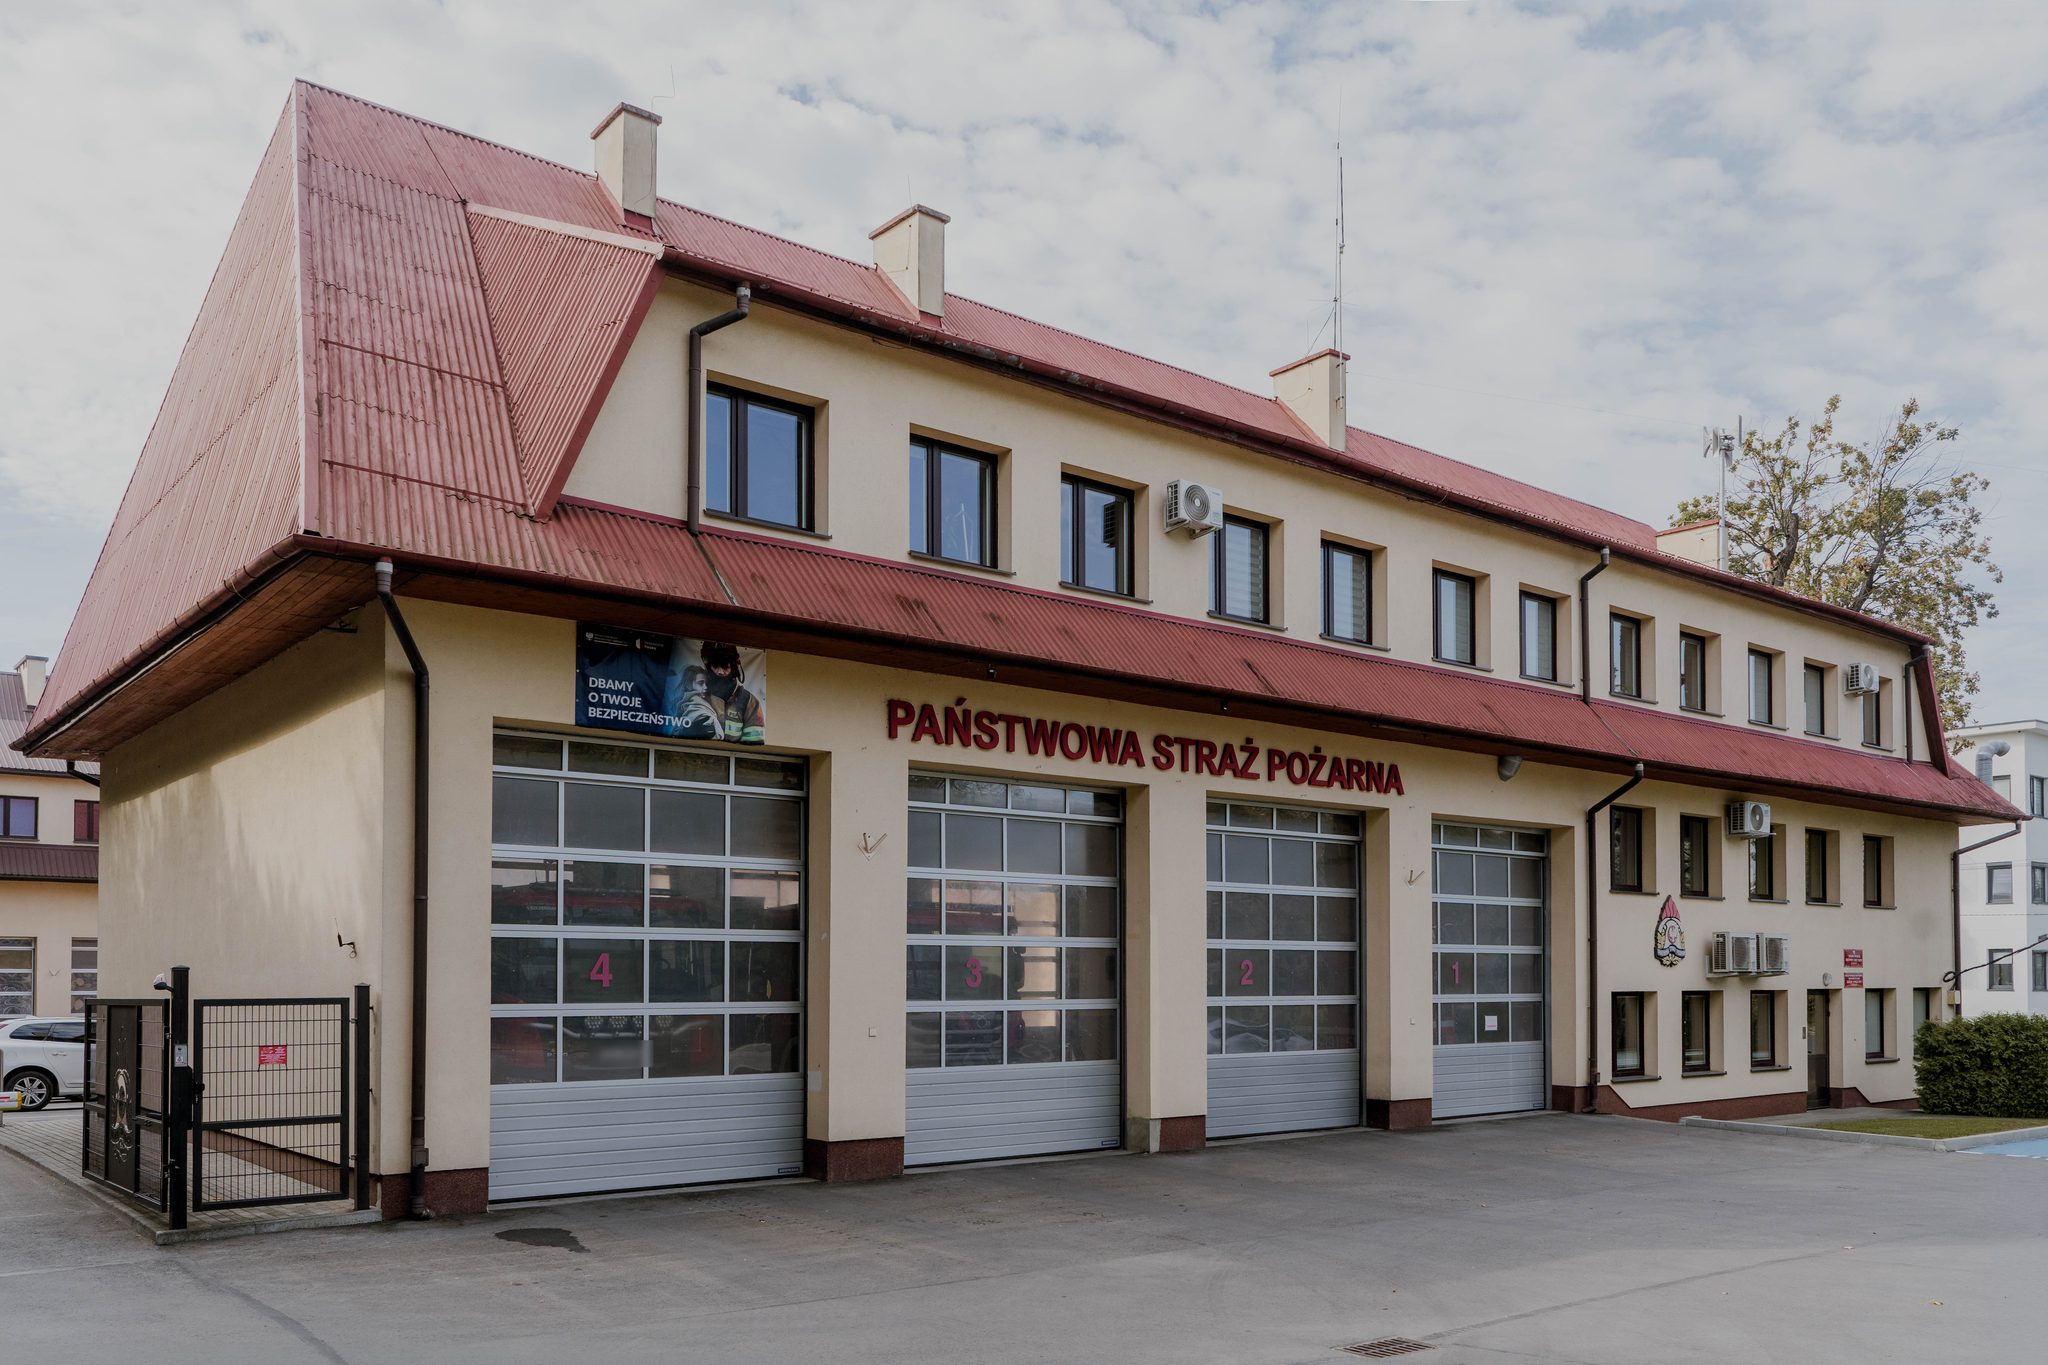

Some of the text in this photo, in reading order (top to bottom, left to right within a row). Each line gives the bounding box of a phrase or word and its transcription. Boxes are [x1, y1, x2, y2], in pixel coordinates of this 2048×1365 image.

[588, 677, 634, 692] DBAMY
[588, 692, 642, 708] O TWOJE
[588, 706, 692, 728] BEZPIECZEŃSTWO
[887, 697, 1405, 796] PAŃSTWOWA STRAŻ POŻARNA
[589, 953, 613, 988] 4
[964, 957, 983, 989] 3
[1240, 959, 1254, 986] 2
[1451, 960, 1461, 984] 1
